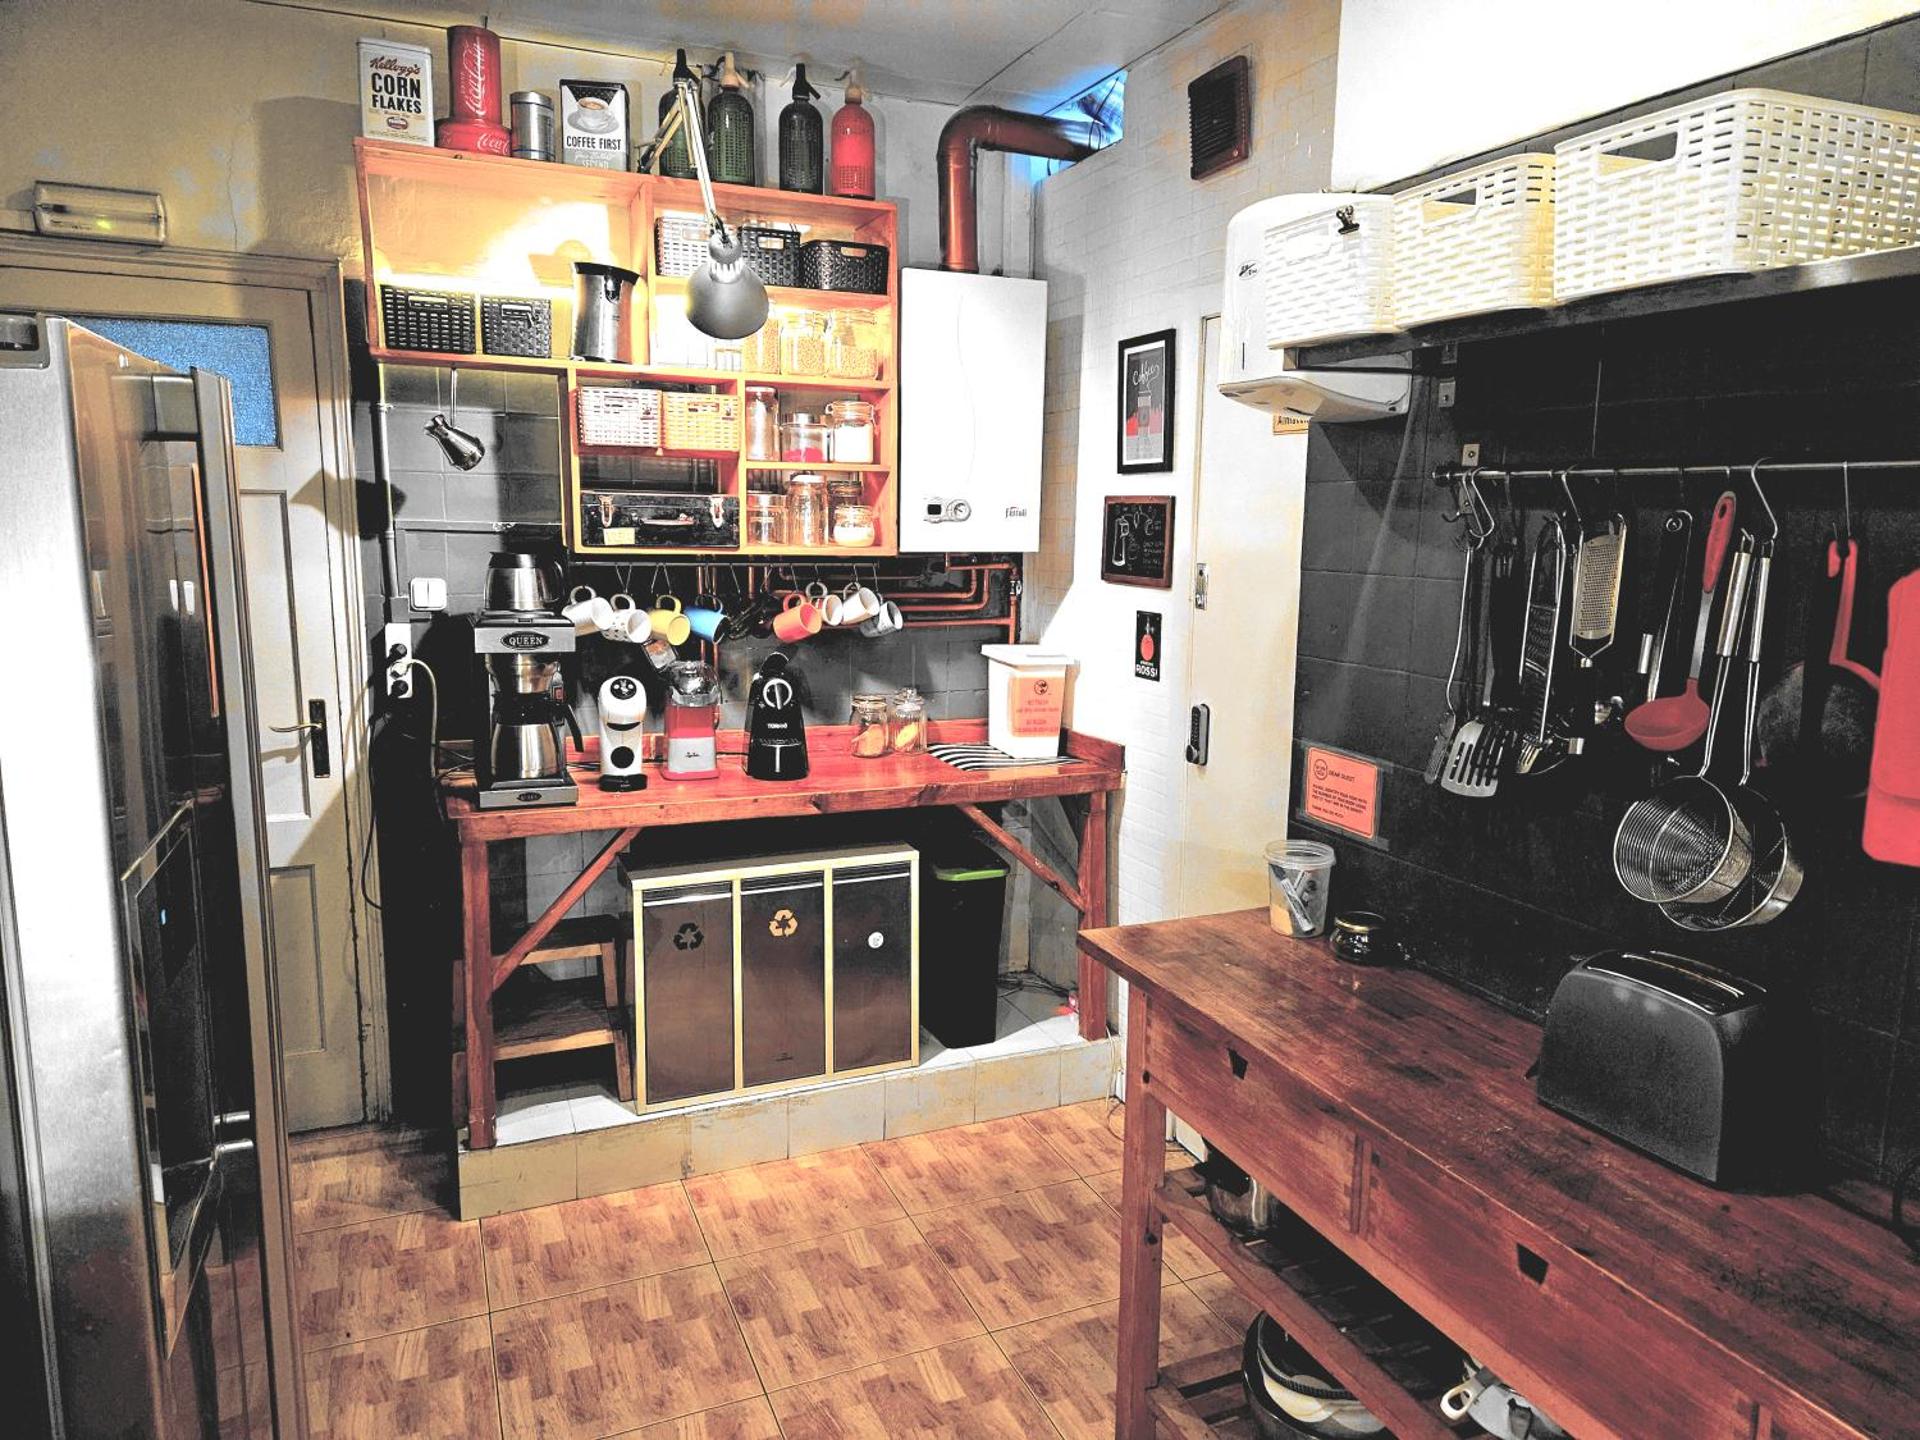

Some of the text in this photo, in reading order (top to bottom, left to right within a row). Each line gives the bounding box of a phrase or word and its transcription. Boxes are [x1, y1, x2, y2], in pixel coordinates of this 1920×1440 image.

[369, 56, 421, 76] Kellogg's
[371, 72, 421, 98] CORN
[372, 94, 422, 114] FLAKES
[566, 135, 622, 151] COFFEE FIRST
[508, 636, 543, 646] QUEEN
